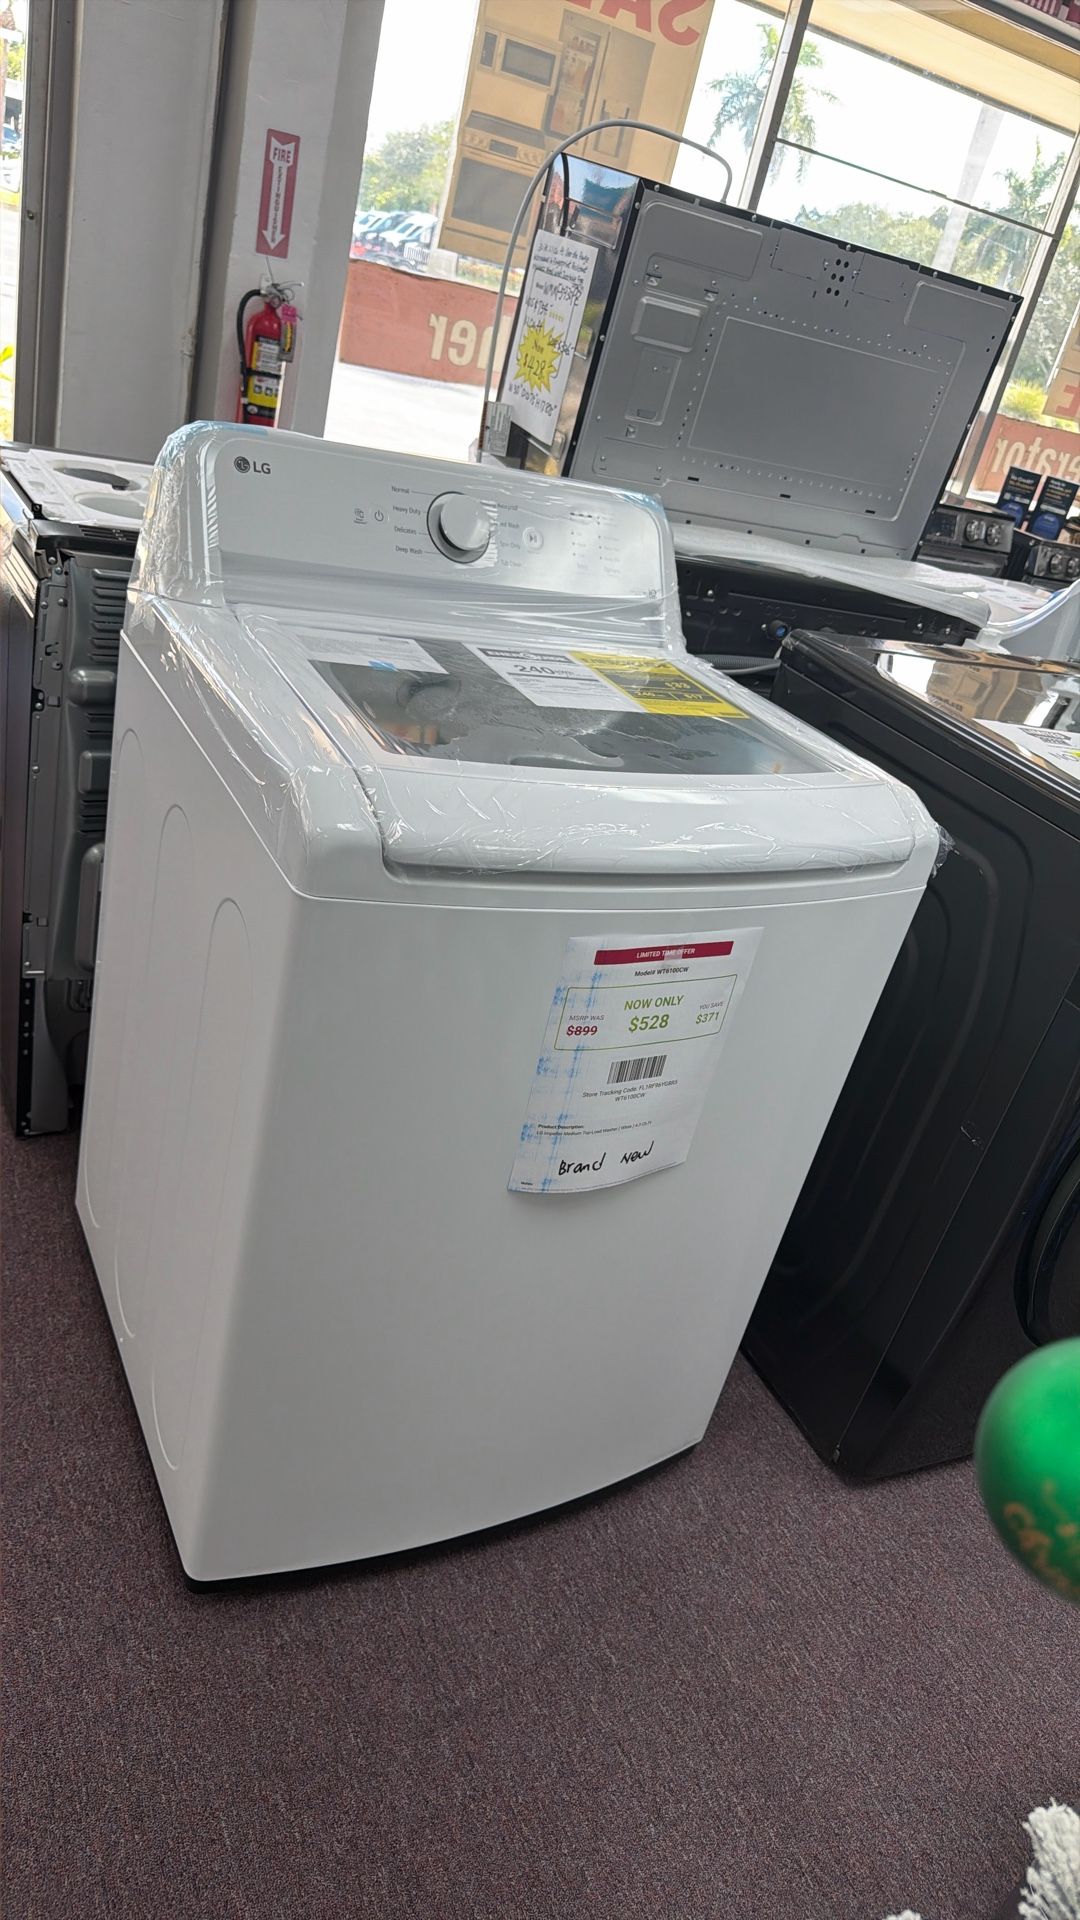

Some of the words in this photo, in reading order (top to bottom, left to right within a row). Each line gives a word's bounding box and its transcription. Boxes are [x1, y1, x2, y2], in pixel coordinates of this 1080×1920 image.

[273, 147, 292, 164] FIRE
[253, 461, 271, 474] LG
[392, 486, 410, 494] Normal
[393, 506, 408, 514] Heavy
[409, 507, 421, 516] Duty
[394, 526, 417, 535] Delicates
[395, 545, 408, 553] Deep
[513, 664, 555, 675] 240
[636, 950, 661, 959] LIMITED
[661, 949, 677, 957] TIME
[677, 948, 696, 956] OFFER
[634, 968, 656, 977] Model#
[656, 966, 690, 975] WT6100CW
[624, 998, 653, 1011] NOW
[654, 995, 685, 1008] ONLY
[711, 1001, 725, 1009] SAVE
[628, 1014, 670, 1033] $528
[695, 1011, 720, 1025] $371
[566, 1025, 598, 1037] $899
[600, 1088, 622, 1096] Tracking
[558, 1152, 607, 1175] Brand
[620, 1140, 655, 1164] New
